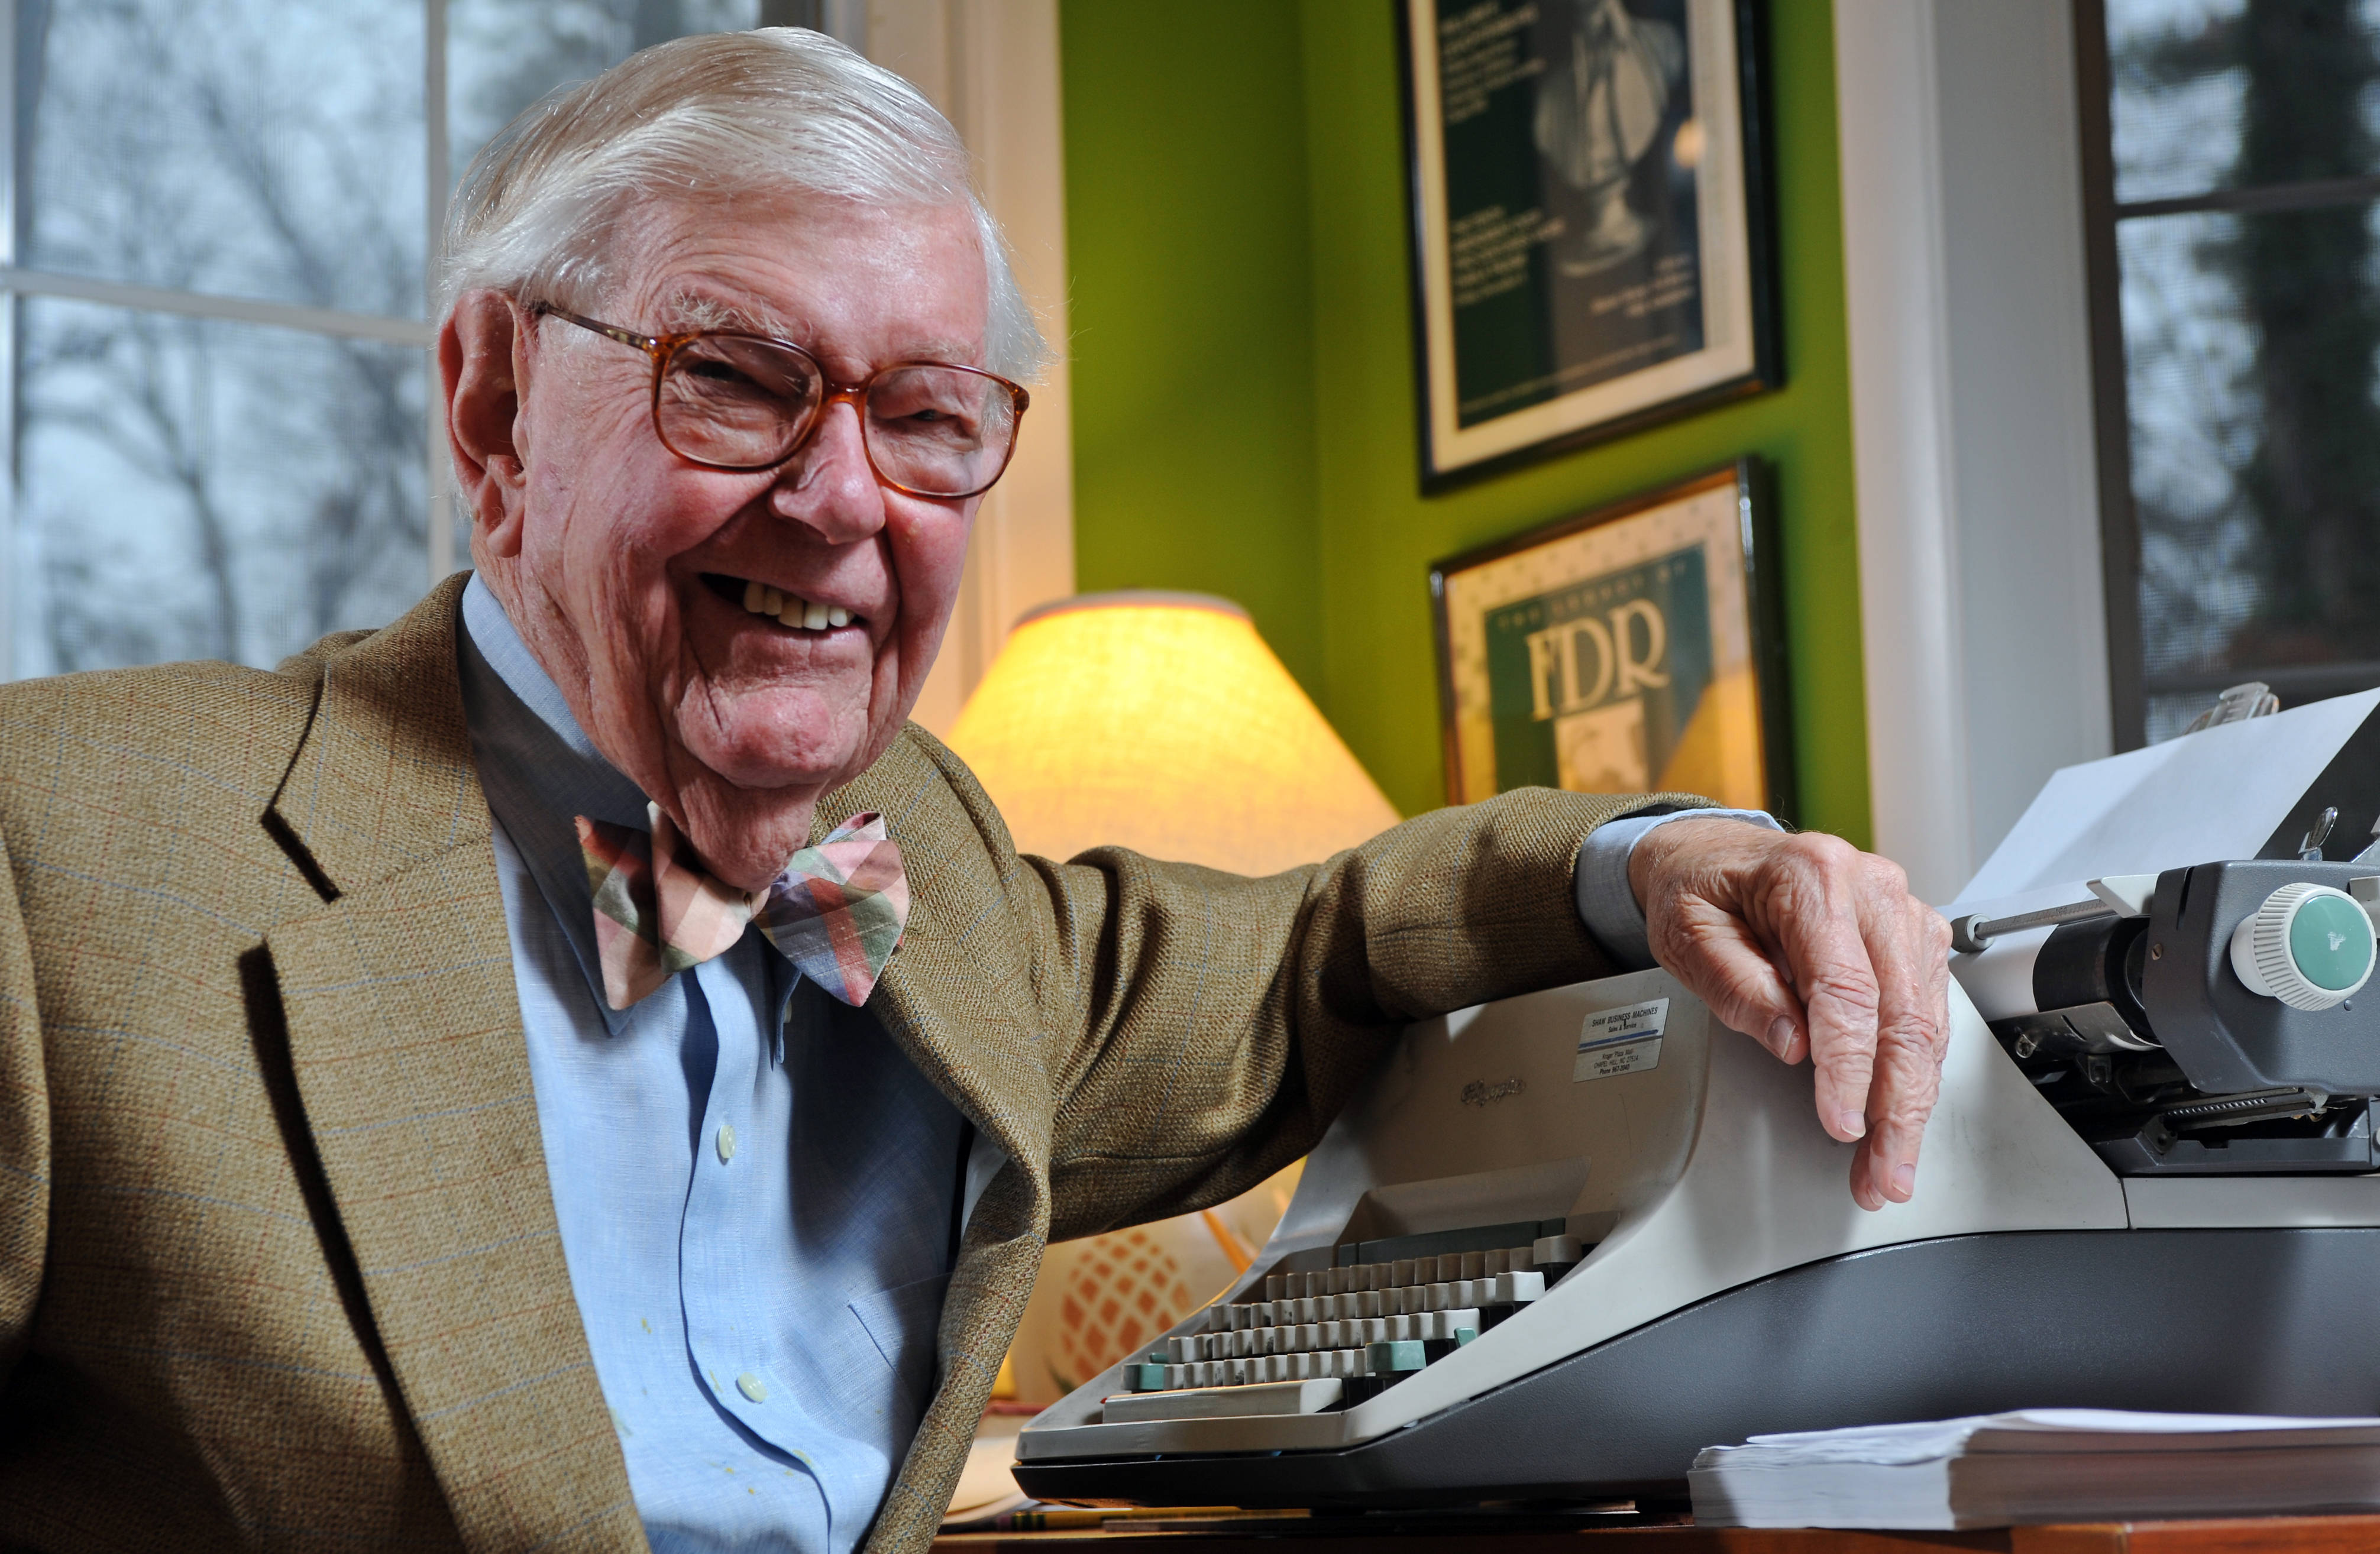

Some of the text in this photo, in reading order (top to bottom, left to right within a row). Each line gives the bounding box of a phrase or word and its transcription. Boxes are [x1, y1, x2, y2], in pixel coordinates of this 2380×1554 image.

[1525, 598, 1670, 721] FDR
[1592, 1006, 1658, 1027] SHAW BUSINESS MACHINES
[1594, 1060, 1608, 1069] CHAPEL
